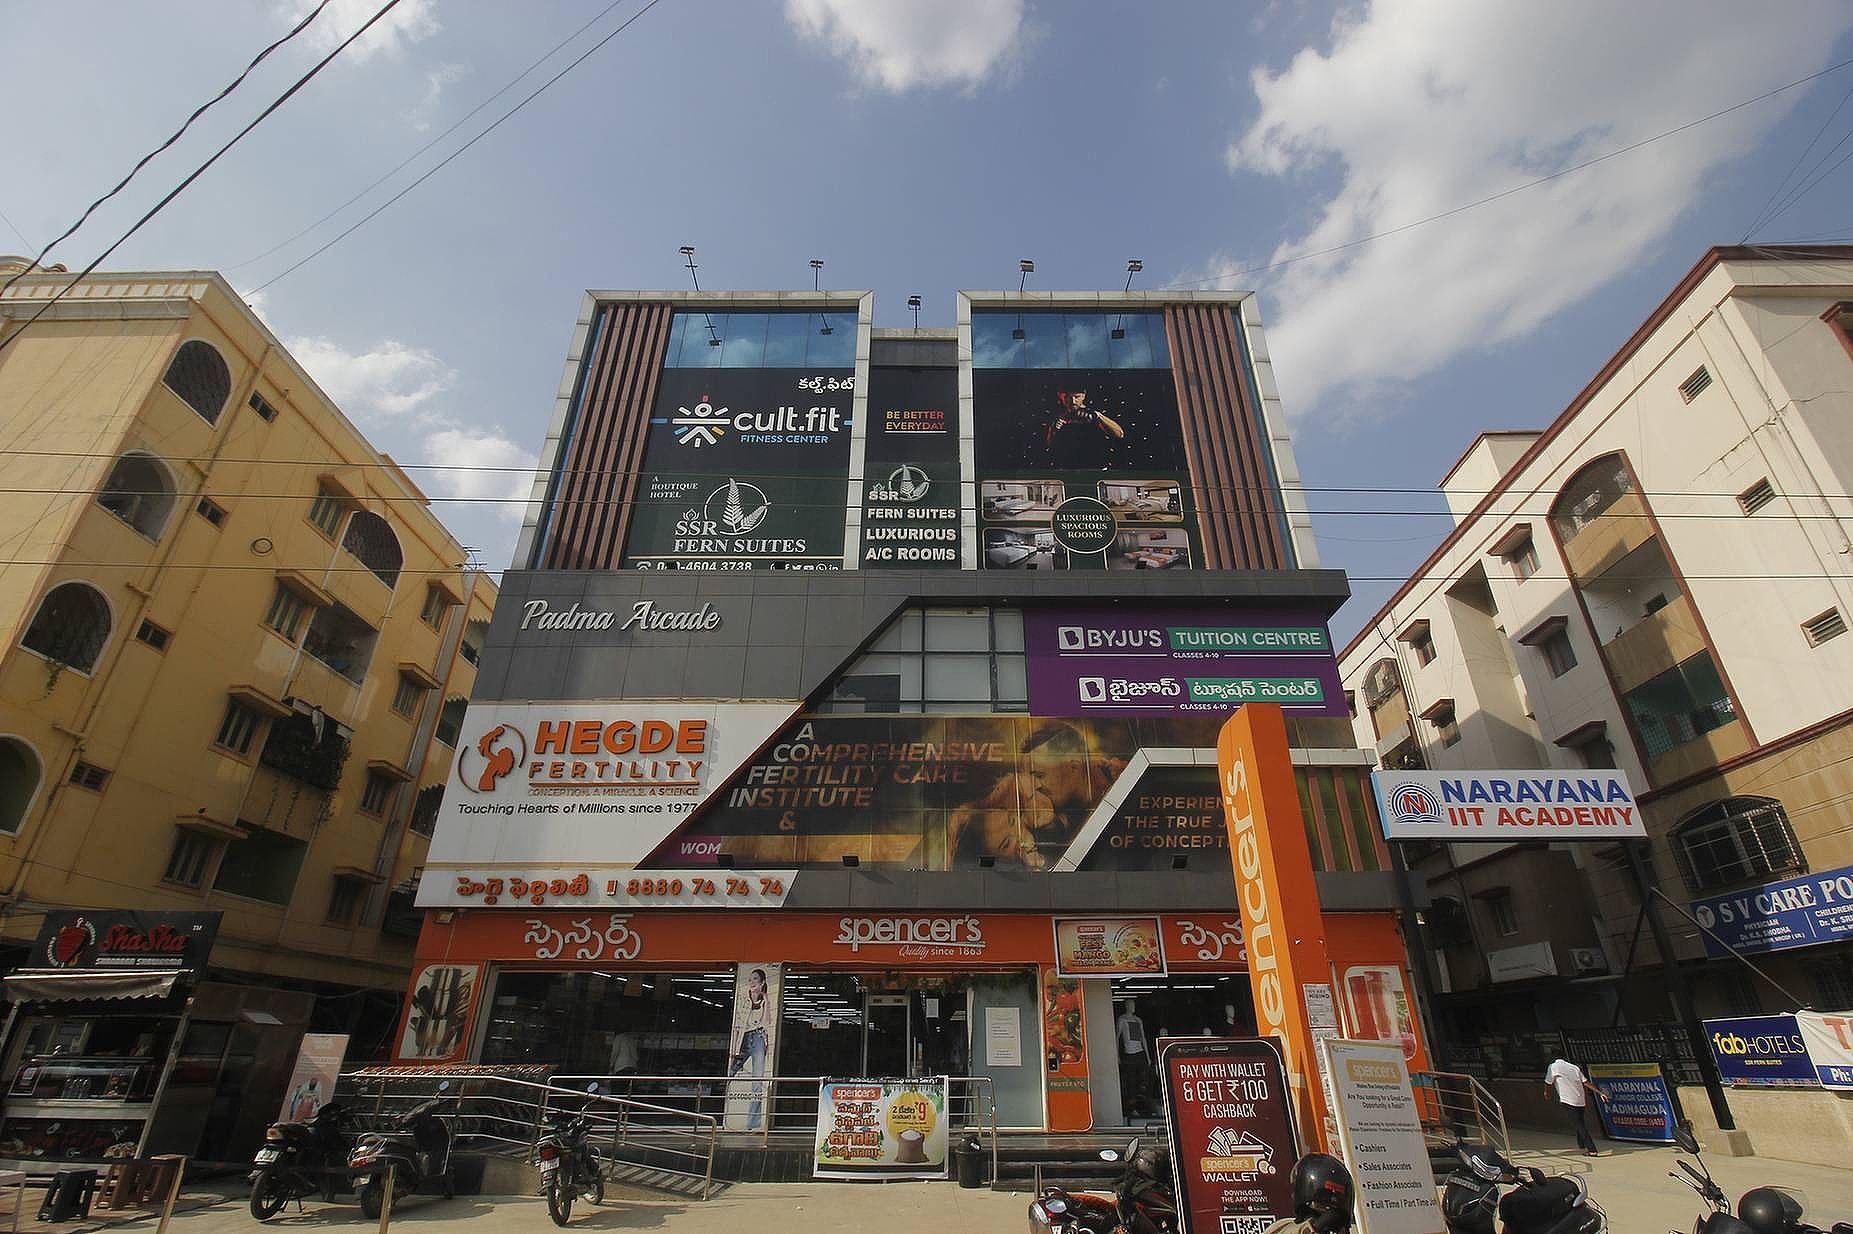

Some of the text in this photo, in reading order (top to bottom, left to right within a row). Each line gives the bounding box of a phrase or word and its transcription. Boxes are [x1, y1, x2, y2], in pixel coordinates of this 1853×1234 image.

[733, 406, 840, 432] cult.fit
[886, 411, 945, 420] BE BETTER
[885, 422, 945, 430] EVERYDAY
[740, 435, 829, 444] FITNESS CENTER
[869, 491, 899, 500] SSR
[867, 508, 956, 519] FERN SUITES
[1056, 514, 1112, 522] LUXURIOUS
[675, 521, 718, 535] SSR
[866, 528, 957, 540] LUXURIOUS
[673, 539, 808, 553] FERN SUITES
[864, 547, 956, 560] A/C ROOMS
[521, 599, 721, 631] Padma Arcade
[1087, 629, 1163, 648] BYJU'S
[1176, 632, 1247, 646] TUITION
[1252, 632, 1321, 646] CENTRE
[1180, 703, 1228, 711] CLASSES 4-10
[533, 720, 708, 755] HEGDE
[795, 722, 815, 741] A
[773, 743, 1006, 763] COMPREHENSIVE
[529, 761, 703, 779] FERTILITY
[747, 765, 968, 785] FERTILITY CARE
[658, 788, 699, 796] SCIENCE
[728, 787, 873, 808] INSTITUTE
[1439, 779, 1633, 803] NARAYANA
[458, 803, 698, 816] Touching Hearts of Millions since 1977
[1450, 807, 1634, 827] IIT ACADEMY
[779, 810, 797, 831] &
[1124, 815, 1159, 828] THE
[1167, 815, 1213, 828] TRUE
[1110, 835, 1231, 848] OF CONCEPT
[626, 879, 784, 896] 8880 74 74 74
[1719, 876, 1853, 924] S V CARE PO
[837, 914, 983, 952] spencer's
[898, 945, 930, 960] Quality
[930, 946, 954, 956] since
[1713, 1032, 1806, 1054] fabHOTELS
[1180, 1062, 1266, 1079] PAY WITH WALLET
[1183, 1079, 1269, 1102] & GET ₹100
[1203, 1103, 1257, 1119] CASHBACK
[1359, 1144, 1387, 1153] Cashiers
[1363, 1162, 1381, 1171] Sales
[1202, 1172, 1259, 1183] WALLET
[1370, 1200, 1384, 1209] Full
